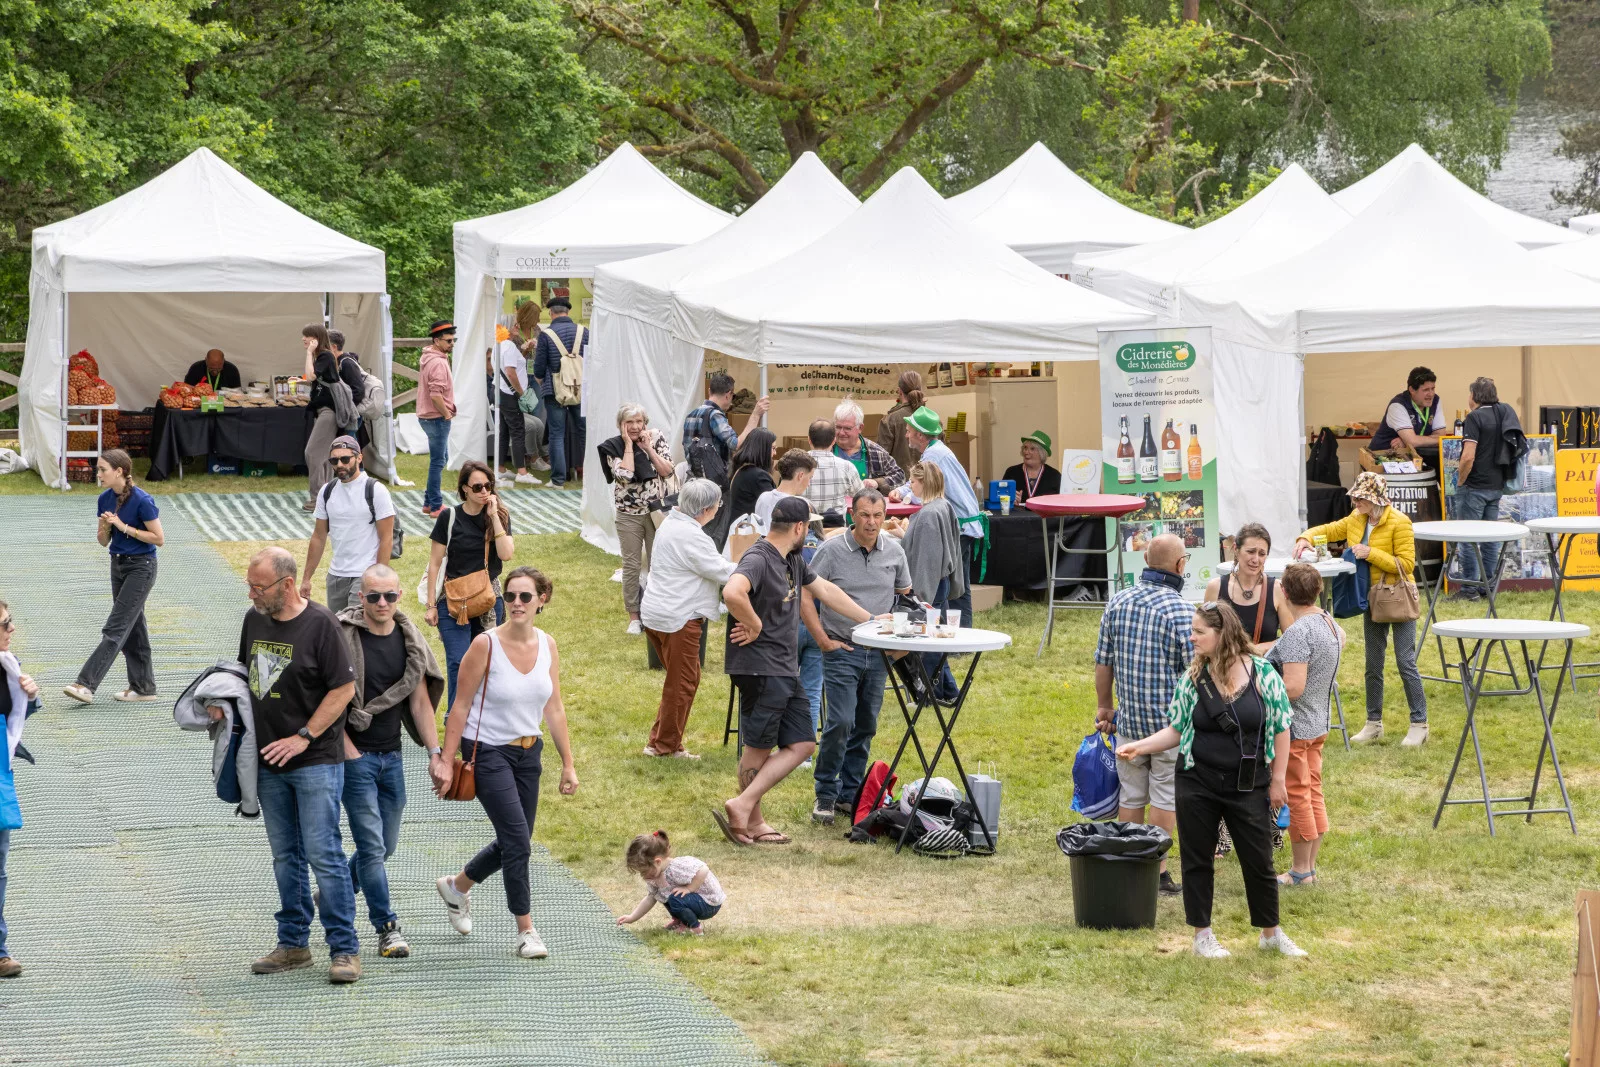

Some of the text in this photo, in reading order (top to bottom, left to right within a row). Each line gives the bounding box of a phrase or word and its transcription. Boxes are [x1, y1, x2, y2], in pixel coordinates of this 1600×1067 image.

[1121, 347, 1173, 361] Cidrerie
[1127, 359, 1187, 370] des Monédières
[846, 365, 891, 376] adaptée
[1134, 390, 1163, 398] découvrir
[1174, 388, 1200, 397] produits
[1142, 399, 1176, 407] l'entreprise
[1178, 398, 1203, 406] adaptée
[1580, 452, 1600, 465] VI
[1564, 469, 1598, 482] PAI
